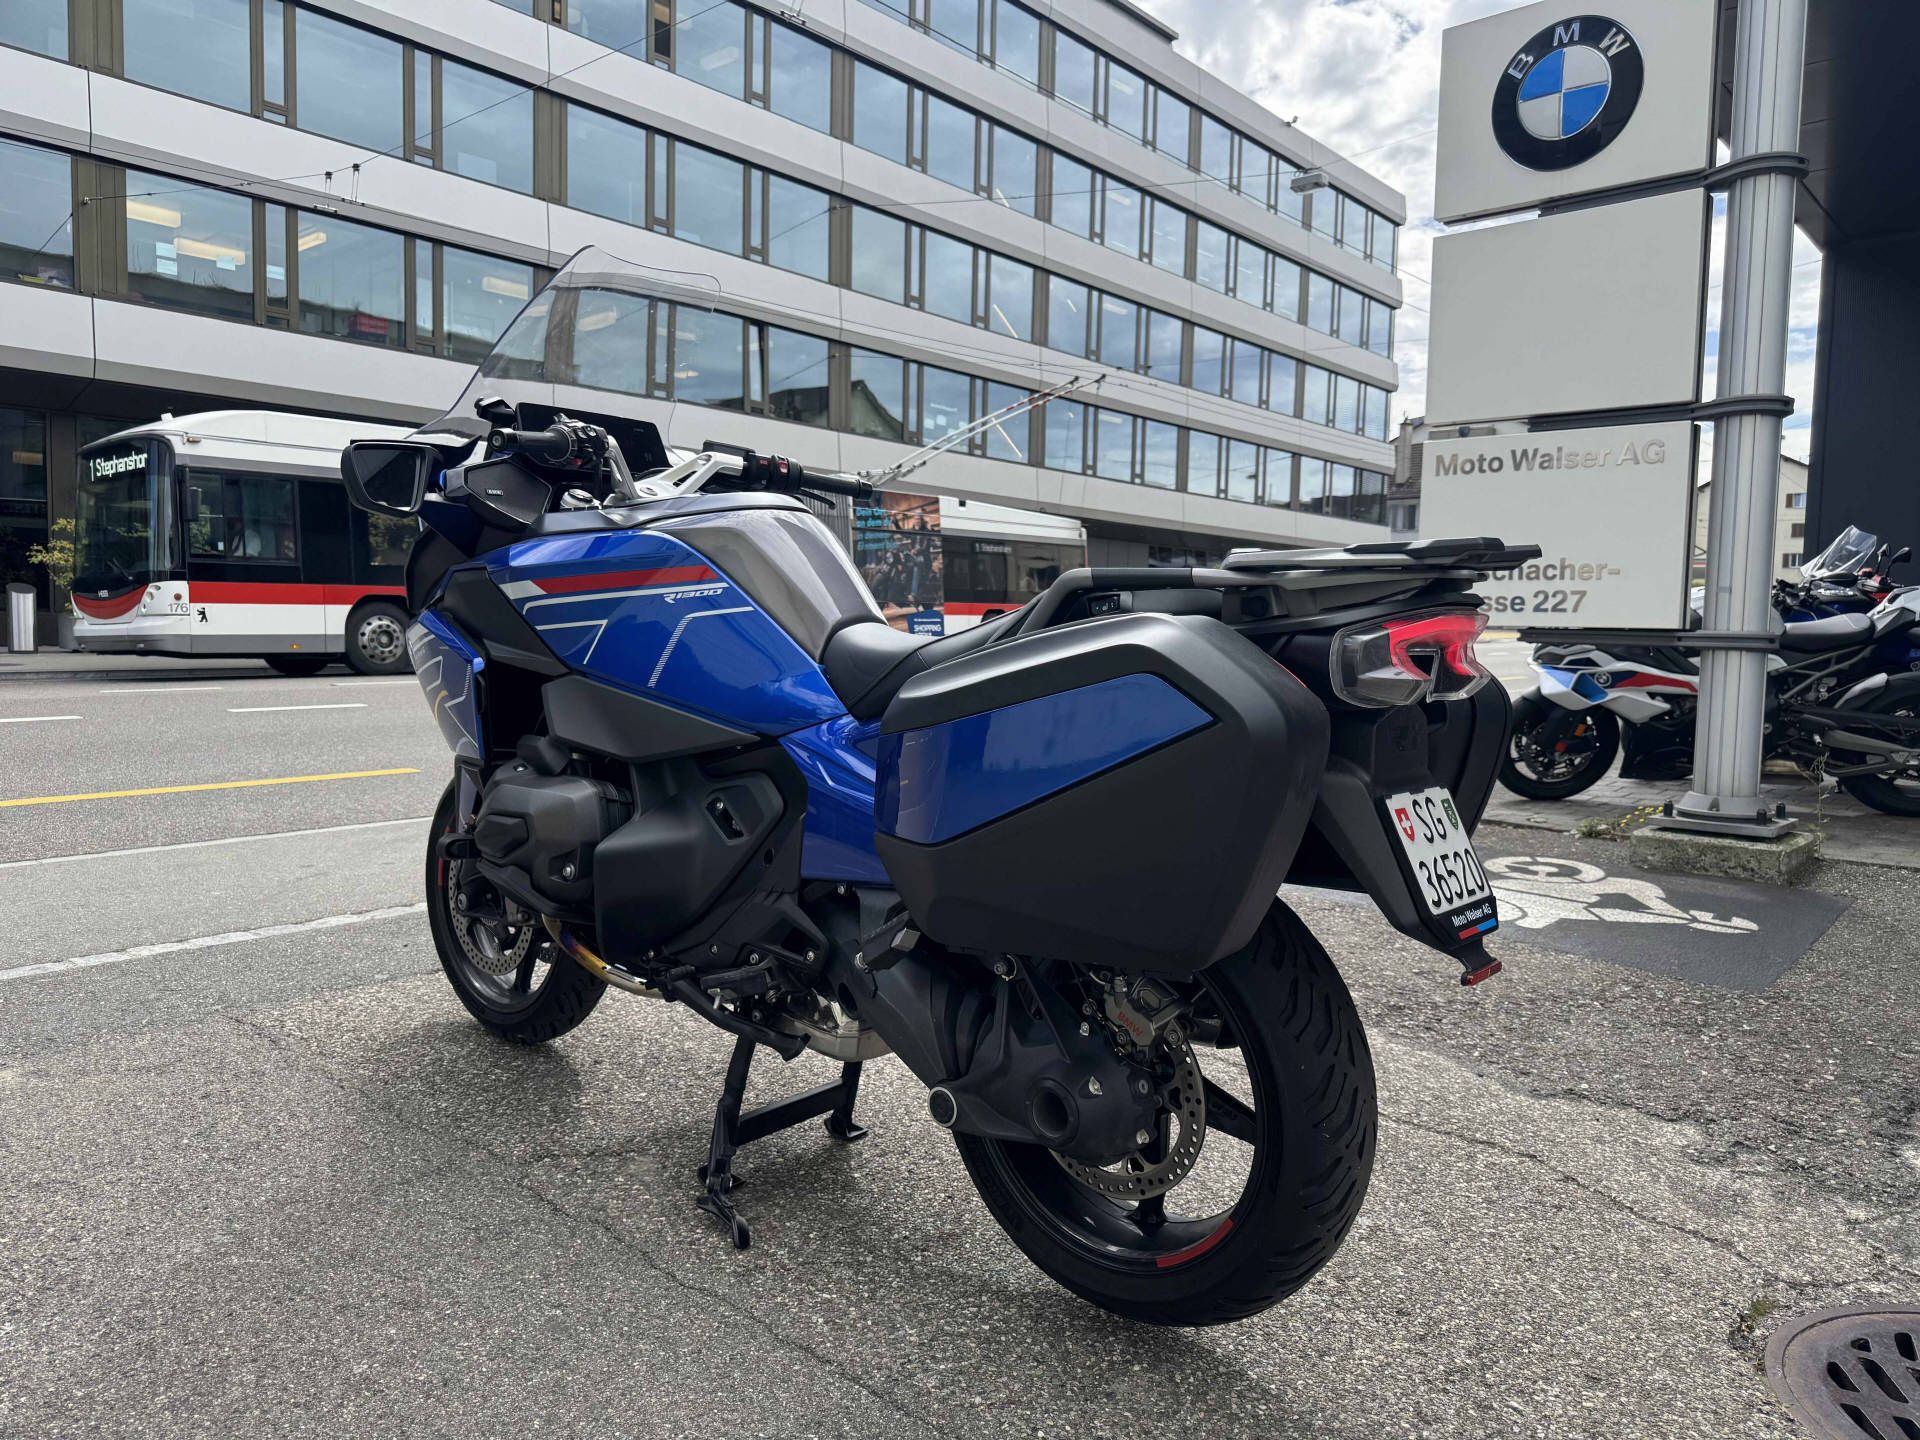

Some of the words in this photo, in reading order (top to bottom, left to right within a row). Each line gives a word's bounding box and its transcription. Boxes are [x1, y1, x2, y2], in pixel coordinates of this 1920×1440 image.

[1508, 21, 1631, 79] BMW
[1434, 453, 1504, 477] Moto
[1511, 446, 1611, 472] Walser
[1615, 438, 1665, 466] AG
[89, 459, 94, 482] 1
[1487, 557, 1621, 581] cacher-
[167, 603, 189, 613] 176
[1532, 590, 1587, 613] 227
[1412, 797, 1447, 844] SG
[1418, 848, 1485, 908] 36520
[1451, 914, 1468, 927] Moto
[1482, 903, 1492, 916] AG
